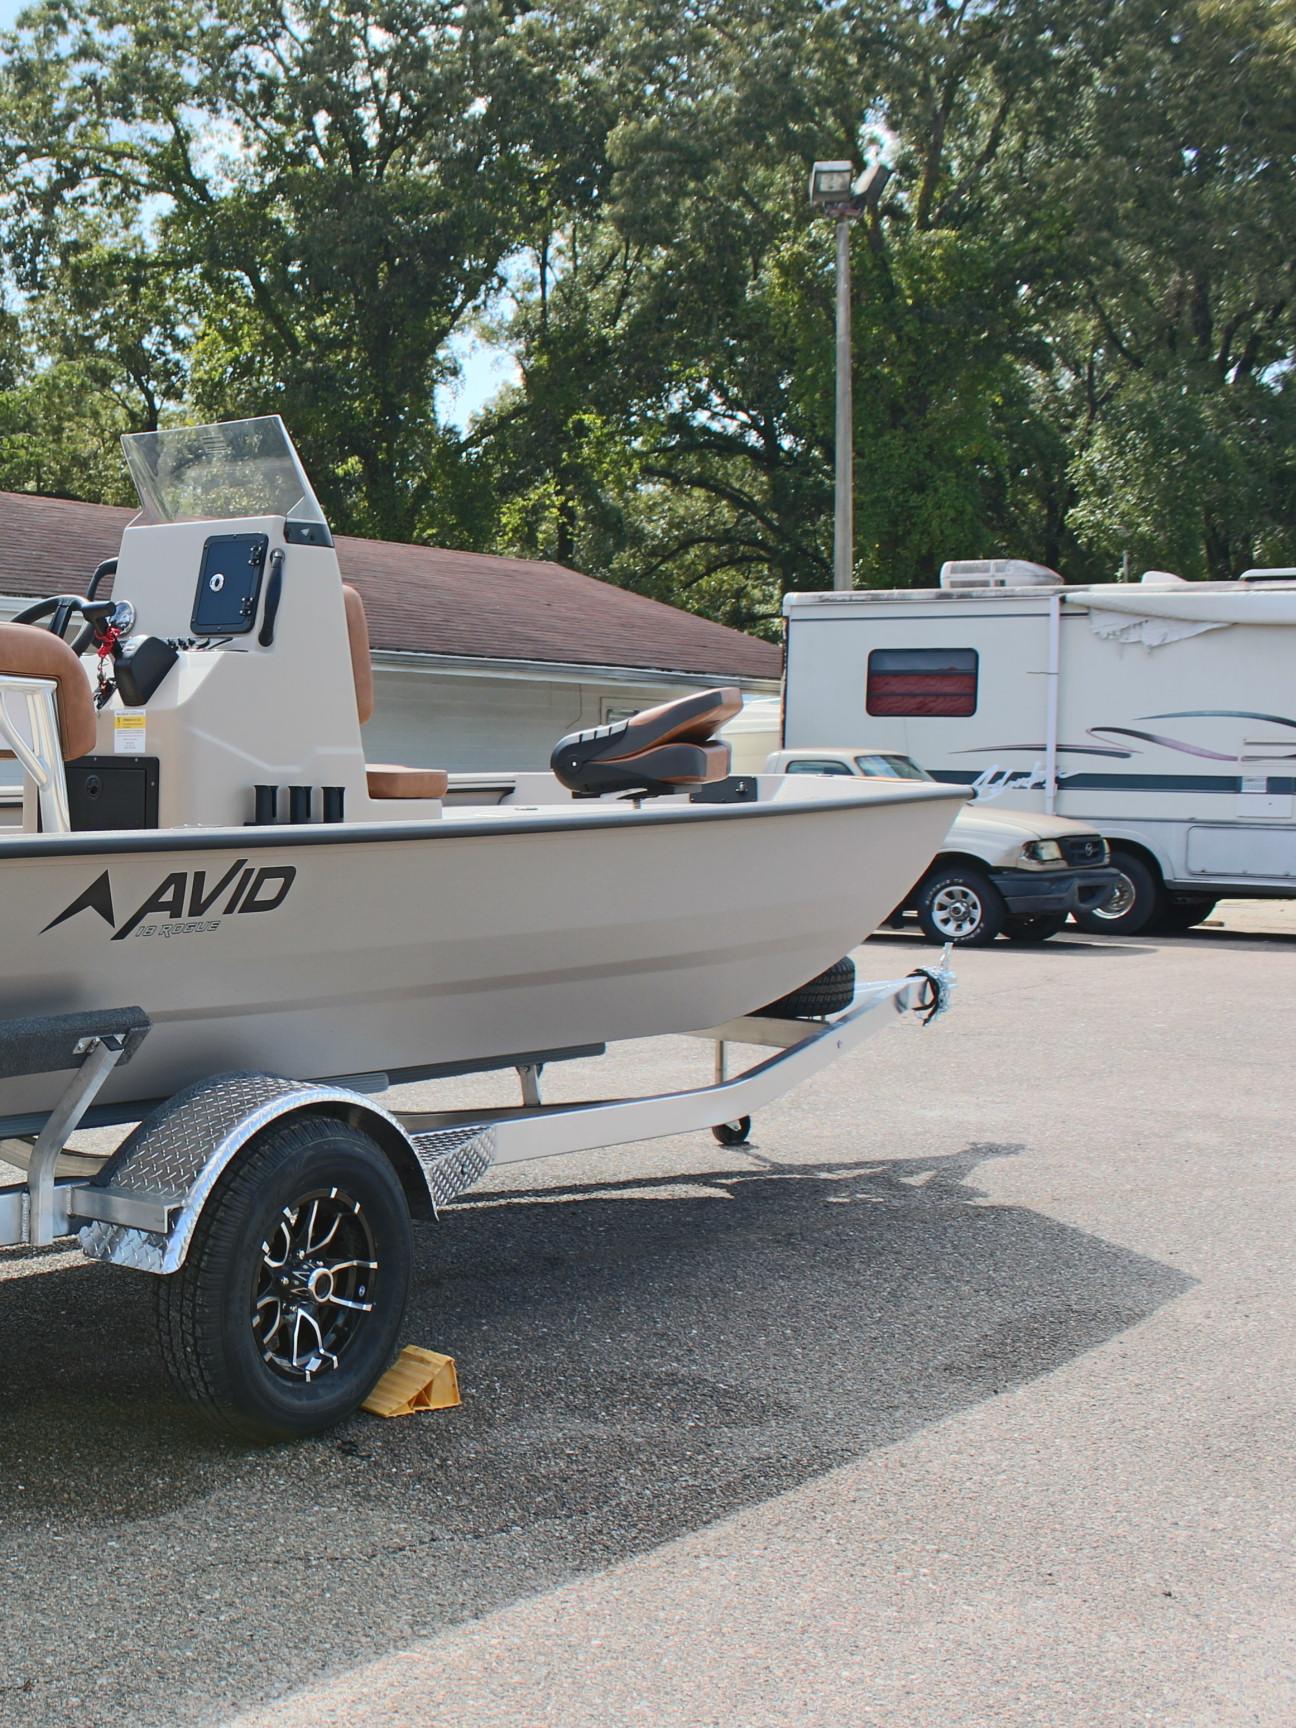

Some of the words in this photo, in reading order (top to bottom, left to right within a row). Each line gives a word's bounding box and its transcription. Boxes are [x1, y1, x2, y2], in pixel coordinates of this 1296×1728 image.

[110, 858, 297, 940] AVID
[135, 925, 157, 938] 18
[158, 920, 221, 938] ROGUE
